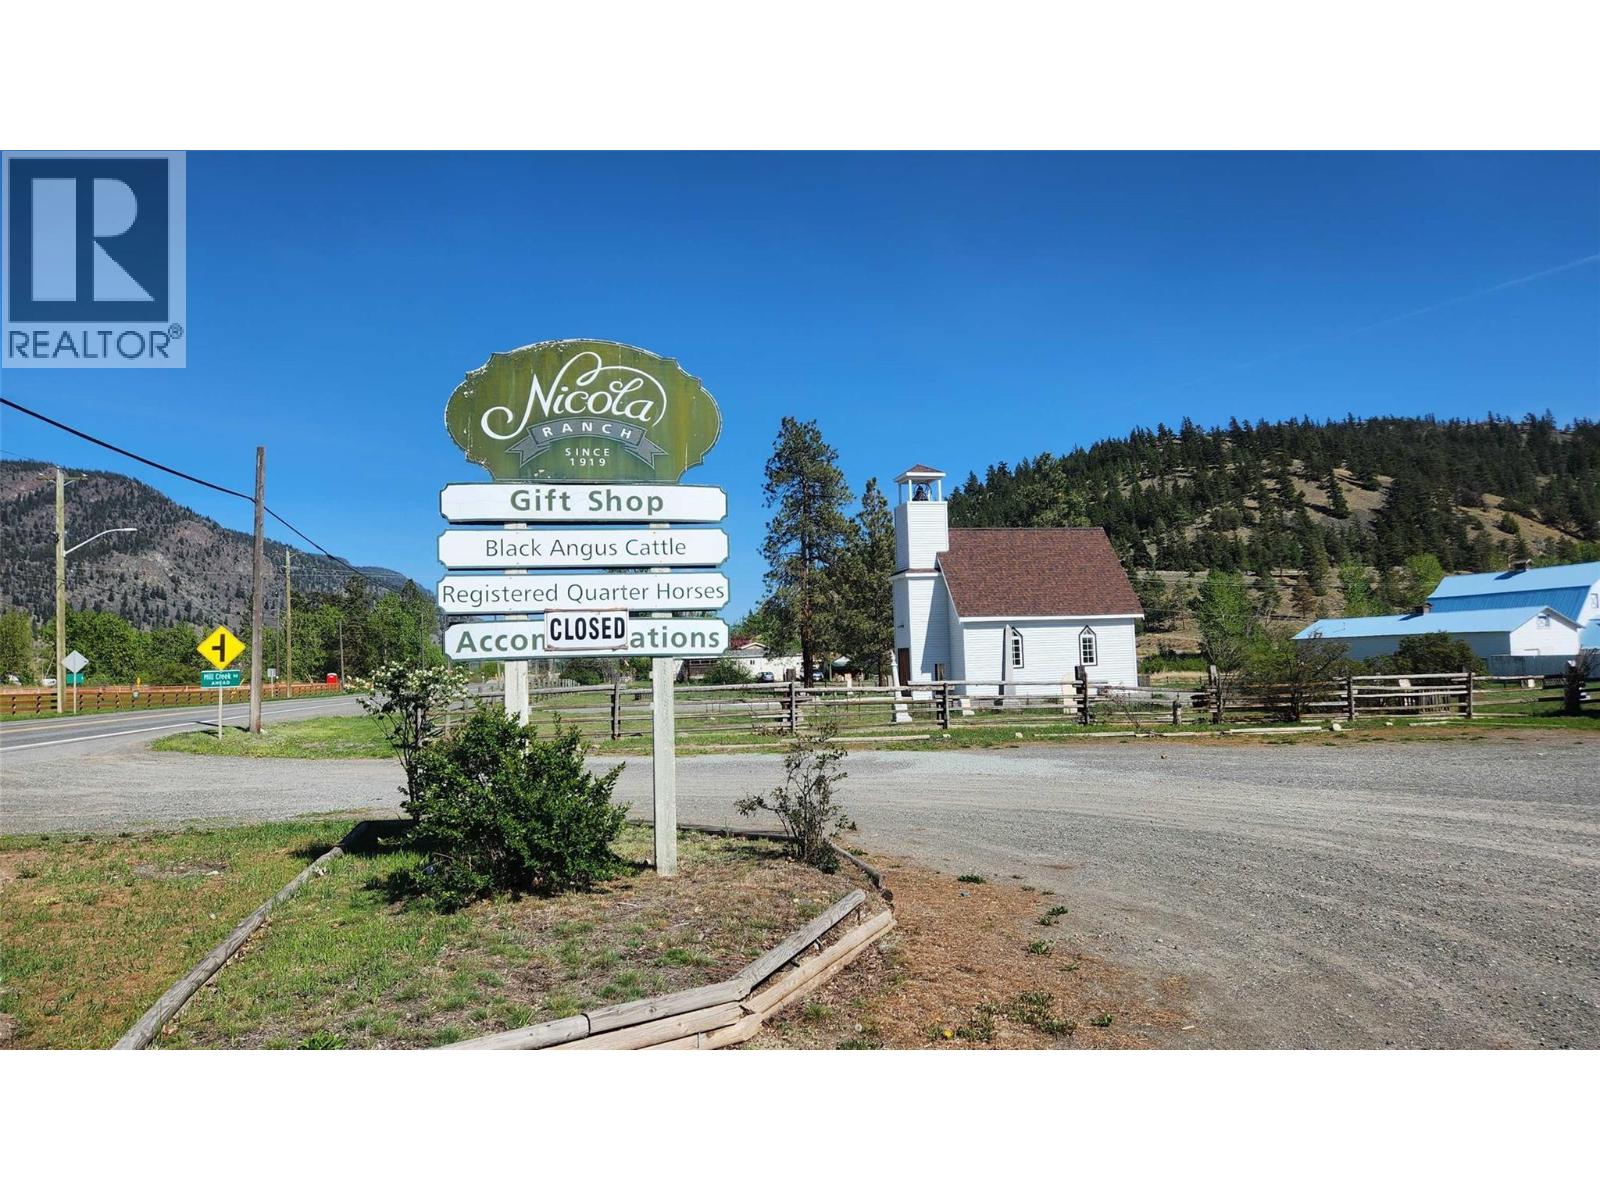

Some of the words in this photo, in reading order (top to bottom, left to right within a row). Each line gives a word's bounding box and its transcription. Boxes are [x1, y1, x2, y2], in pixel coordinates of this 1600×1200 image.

[481, 351, 667, 440] Nicola
[542, 422, 632, 439] RANCH
[565, 448, 610, 457] SINCE
[570, 458, 606, 467] 1919
[510, 489, 571, 512] Gift
[588, 489, 664, 515] Shop
[485, 538, 542, 557] Black
[550, 540, 618, 560] Angus
[625, 537, 687, 556] Cattle
[442, 584, 558, 607] Registered
[567, 584, 649, 604] Quarter
[657, 582, 725, 600] Horses
[455, 626, 720, 653] Accoations
[550, 617, 625, 641] CLOSED
[215, 672, 231, 680] Creek
